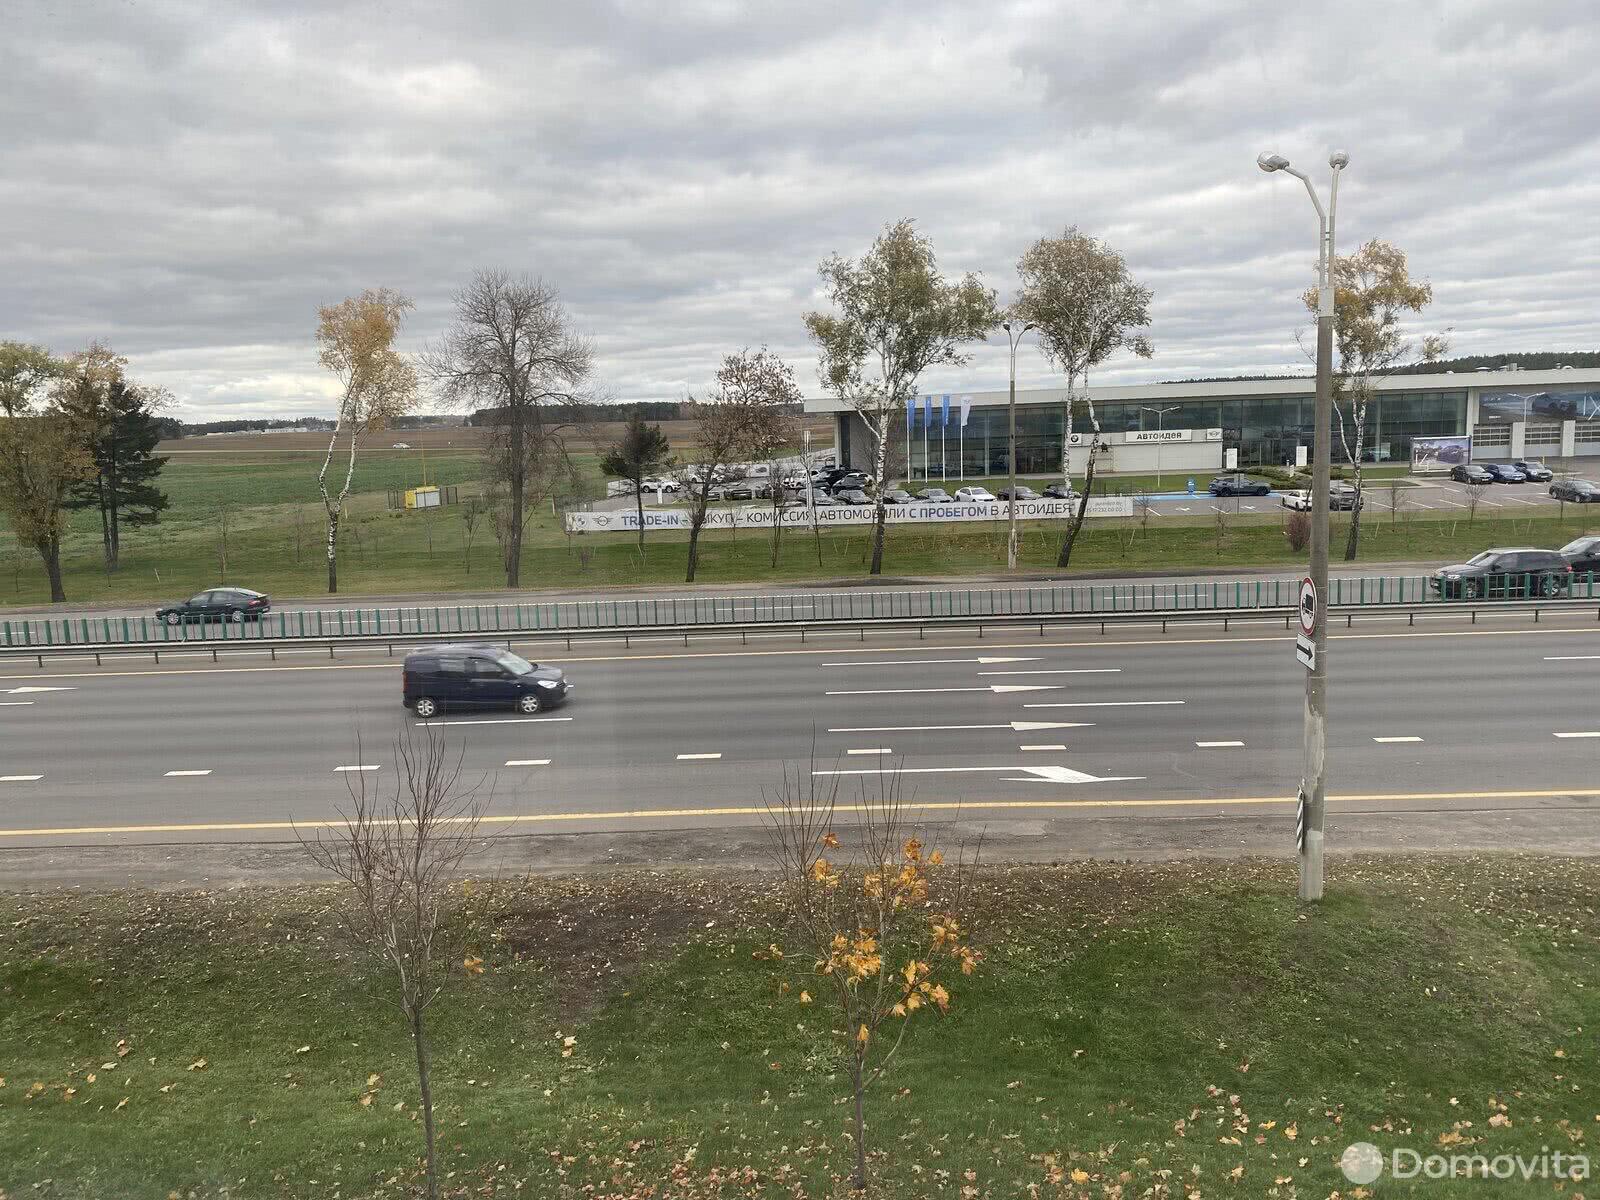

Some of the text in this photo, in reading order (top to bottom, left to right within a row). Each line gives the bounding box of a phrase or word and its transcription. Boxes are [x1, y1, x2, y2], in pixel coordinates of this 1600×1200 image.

[621, 515, 679, 526] TRADE-IN
[696, 513, 734, 524] ЫКУП
[920, 506, 987, 518] ПРОБЕГОМ
[990, 505, 999, 516] В
[1002, 503, 1072, 515] АВТОИДЕЯ
